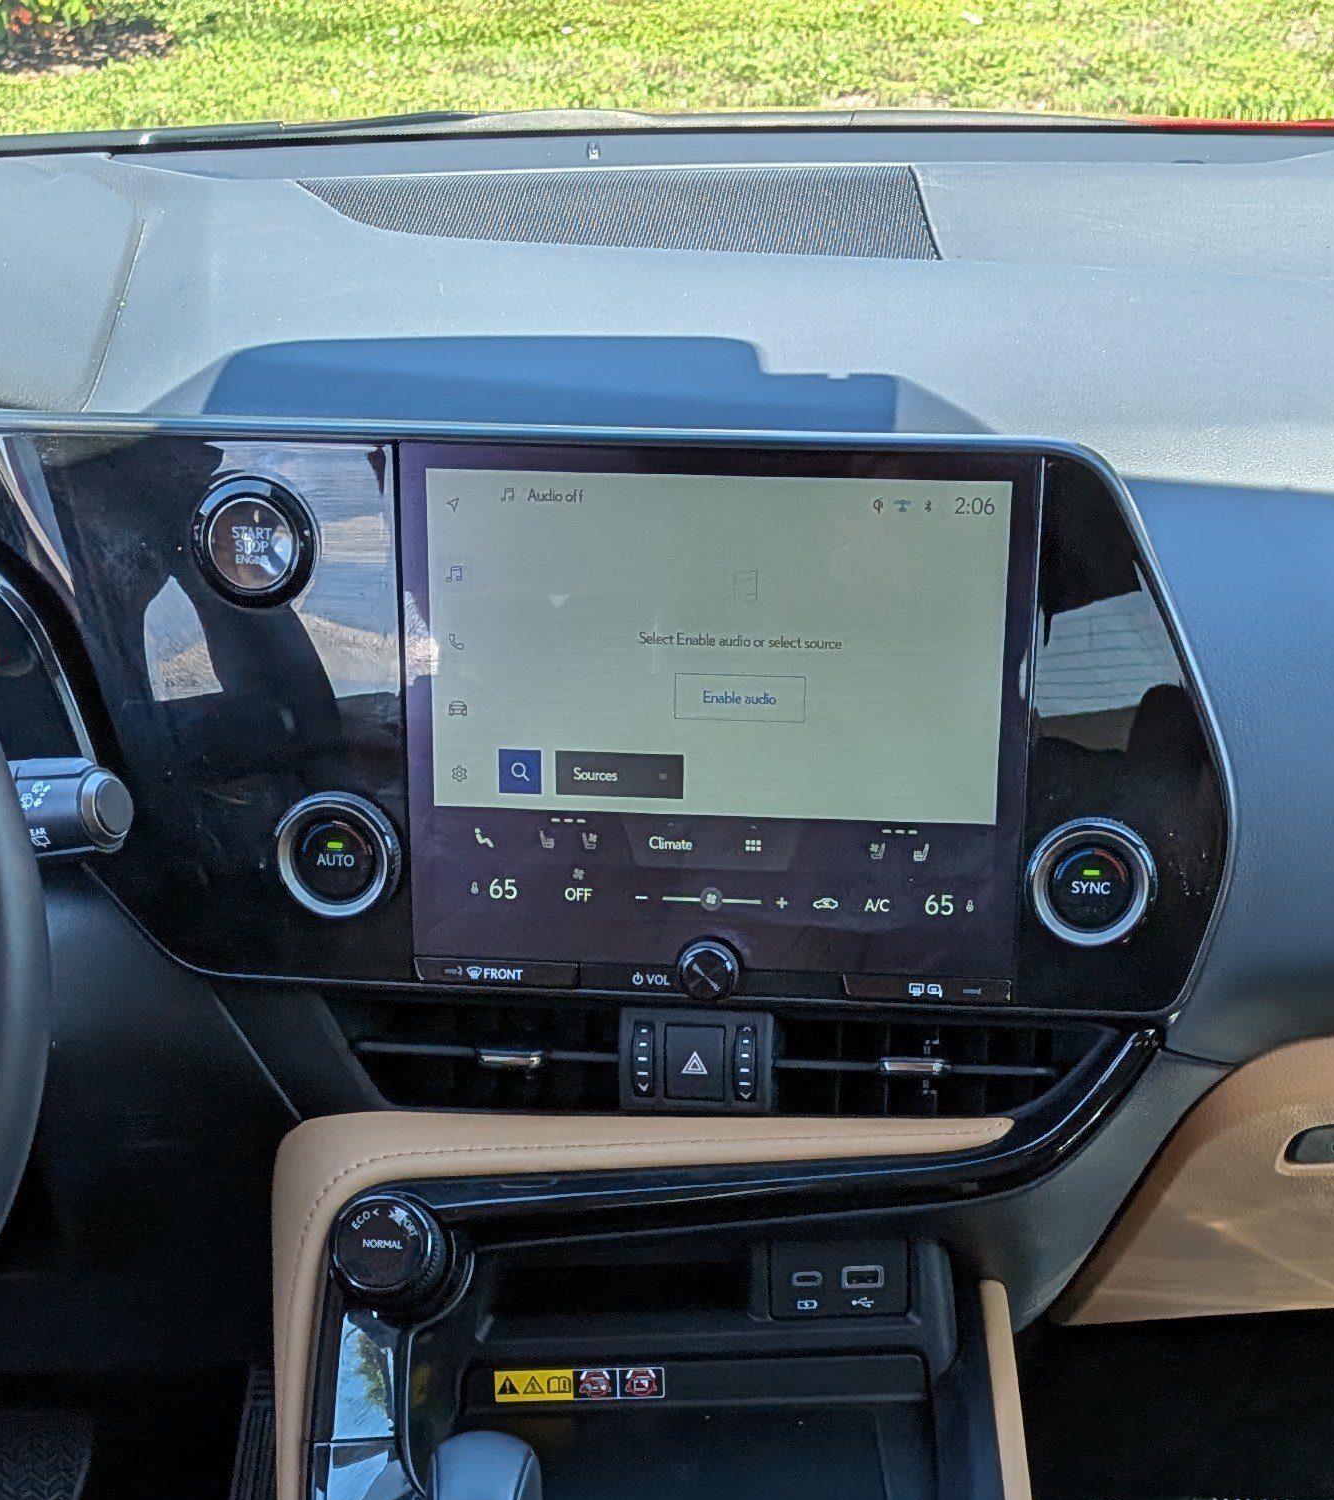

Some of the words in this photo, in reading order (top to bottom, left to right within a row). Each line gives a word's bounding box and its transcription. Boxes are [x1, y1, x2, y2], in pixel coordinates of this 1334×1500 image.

[527, 488, 563, 502] Audio
[565, 489, 584, 503] off
[955, 497, 996, 515] 2:06
[231, 526, 273, 540] START
[235, 540, 269, 554] STOP
[639, 631, 674, 646] Select
[676, 632, 716, 647] Enable
[718, 634, 751, 648] audio
[753, 639, 766, 648] or
[768, 635, 802, 649] select
[804, 639, 842, 650] source
[702, 690, 742, 705] Enable
[744, 692, 777, 706] audio
[573, 767, 618, 782] Sources
[29, 827, 47, 837] EAR
[648, 836, 693, 851] Climate
[316, 853, 355, 867] AUTO
[488, 878, 518, 900] 65
[564, 887, 593, 902] OFF
[1071, 880, 1111, 896] SYNC
[864, 897, 890, 914] A/C
[924, 894, 955, 916] 65
[483, 967, 524, 981] FRONT
[646, 973, 671, 986] VOL
[351, 1210, 371, 1230] ECO
[362, 1239, 404, 1250] NORMAL
